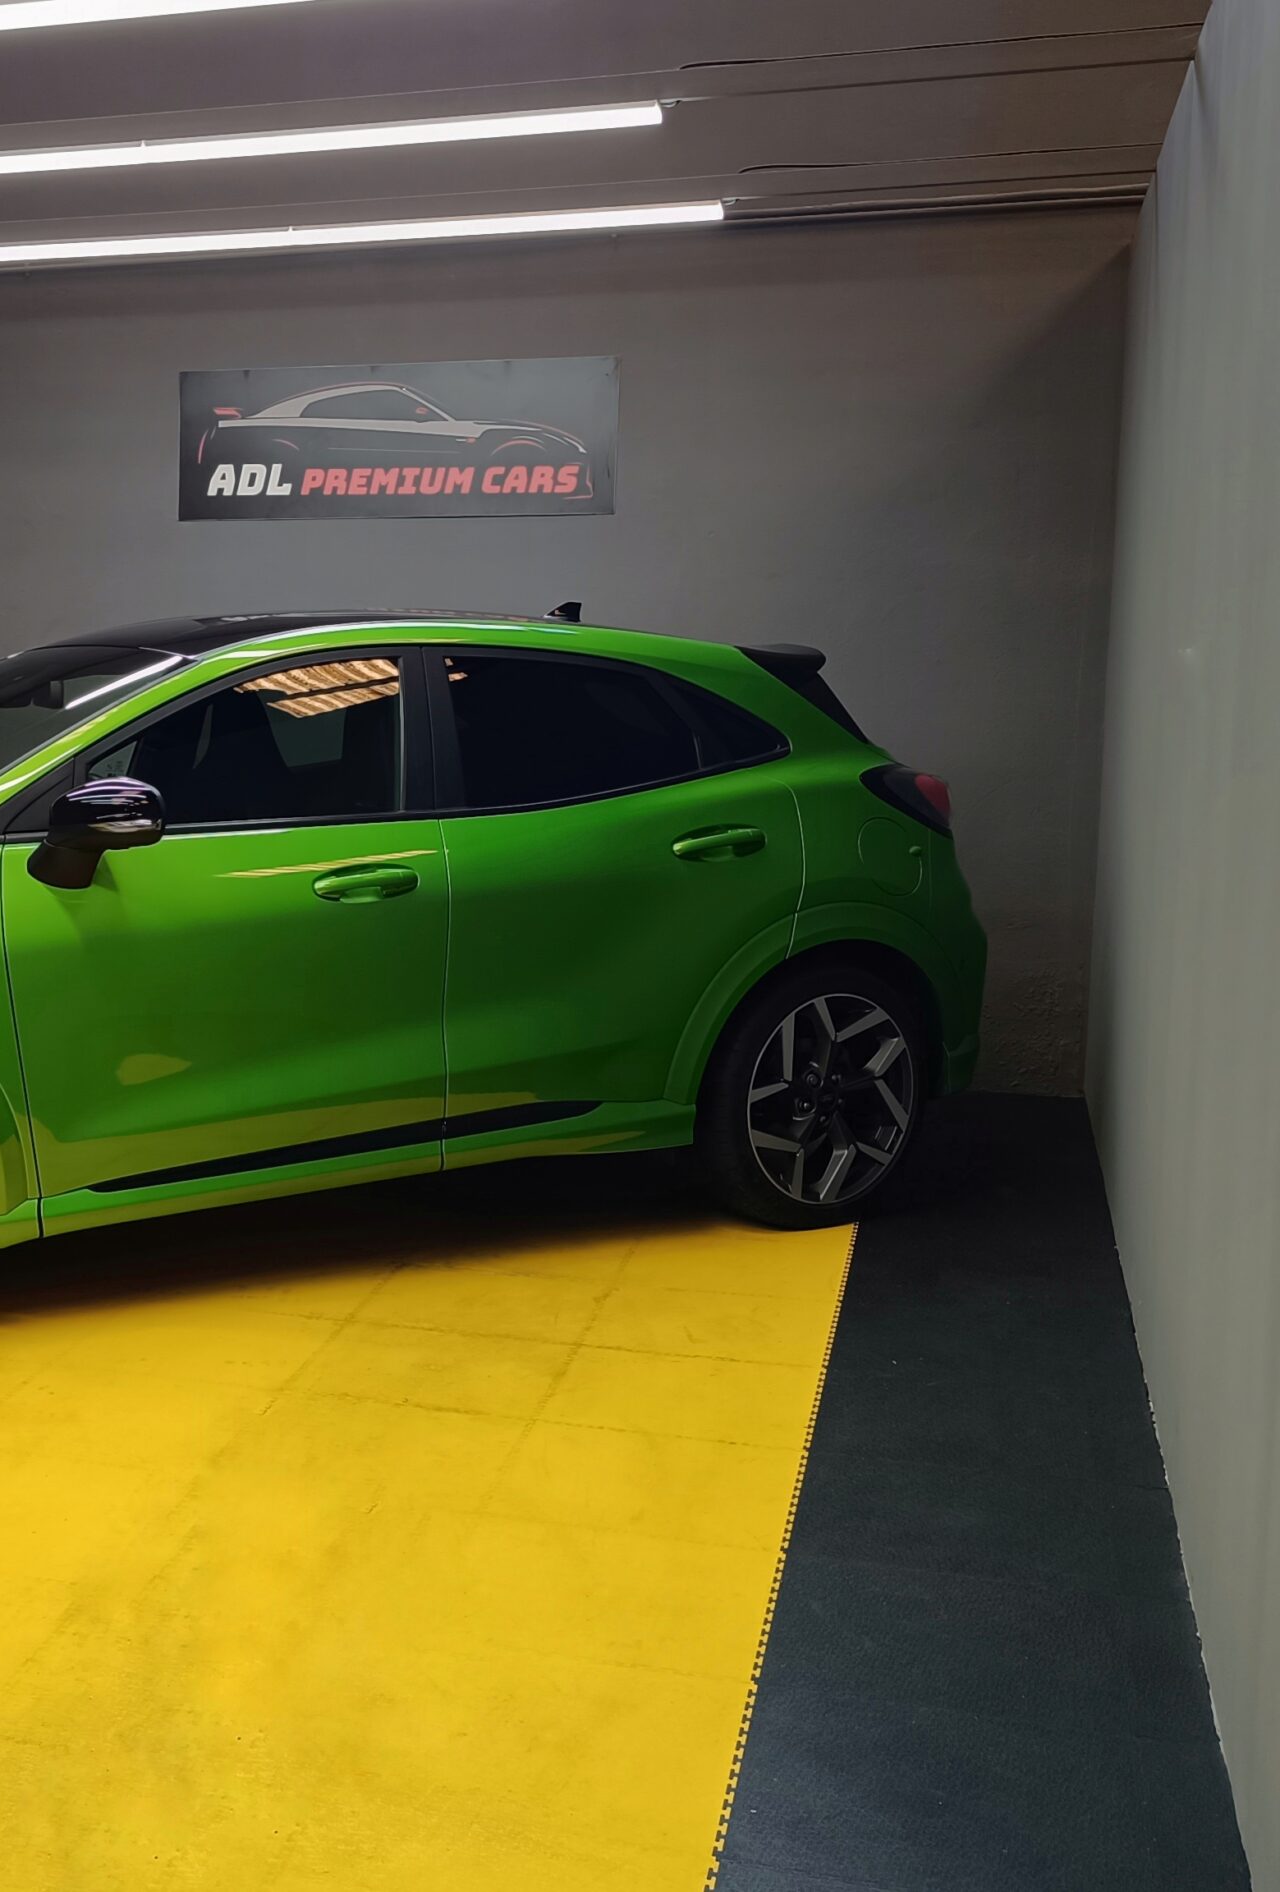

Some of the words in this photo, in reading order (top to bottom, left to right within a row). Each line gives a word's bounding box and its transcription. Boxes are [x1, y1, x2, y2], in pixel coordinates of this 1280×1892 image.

[207, 464, 292, 496] ADL
[300, 467, 475, 495] PREMIUM
[481, 466, 579, 494] CARS
